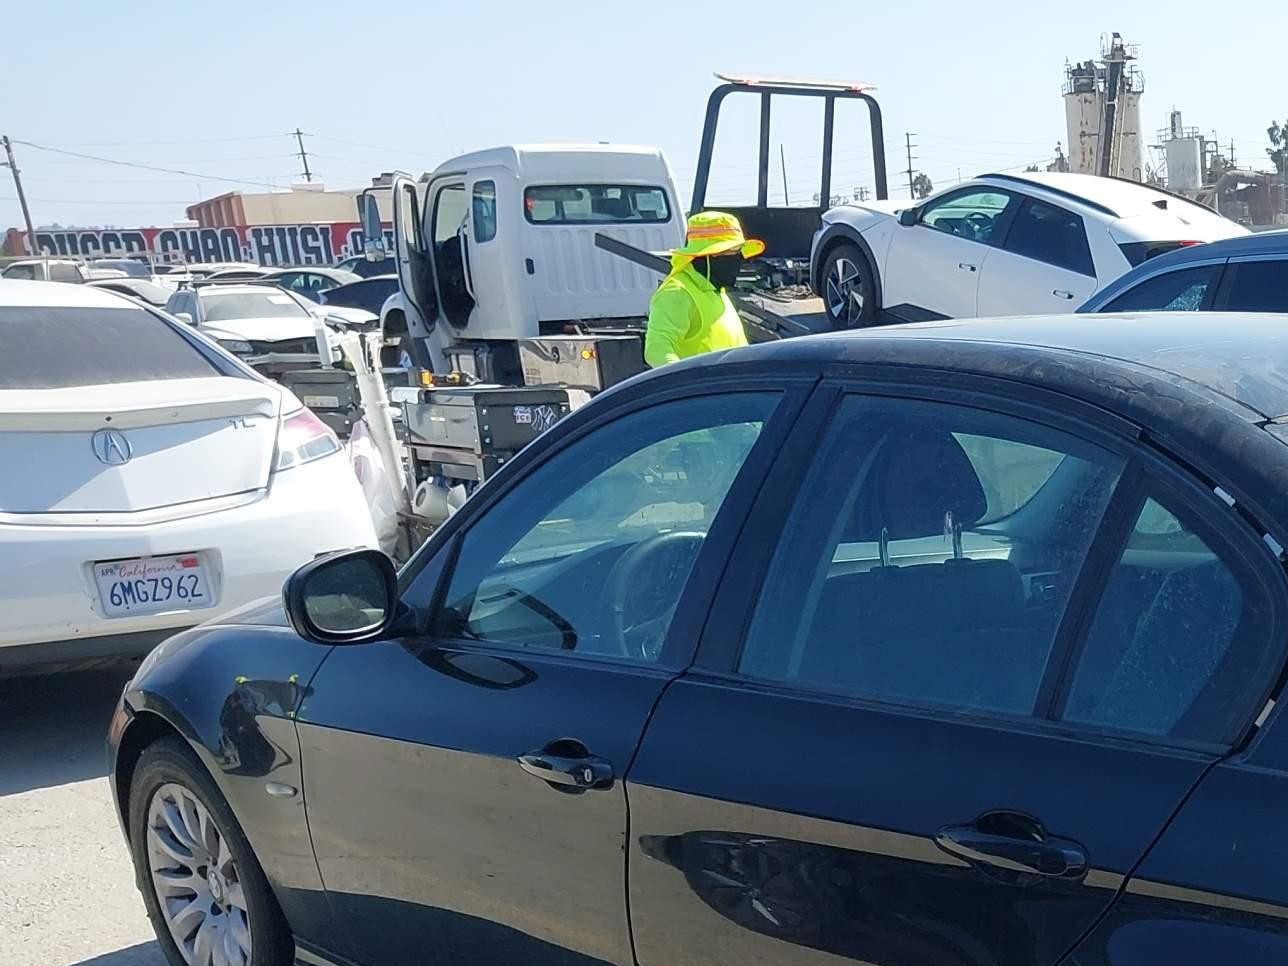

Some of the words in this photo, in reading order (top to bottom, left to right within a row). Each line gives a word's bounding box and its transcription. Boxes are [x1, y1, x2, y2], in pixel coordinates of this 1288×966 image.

[101, 567, 116, 577] APR
[118, 560, 183, 579] California
[109, 574, 204, 608] 6MGZ962
